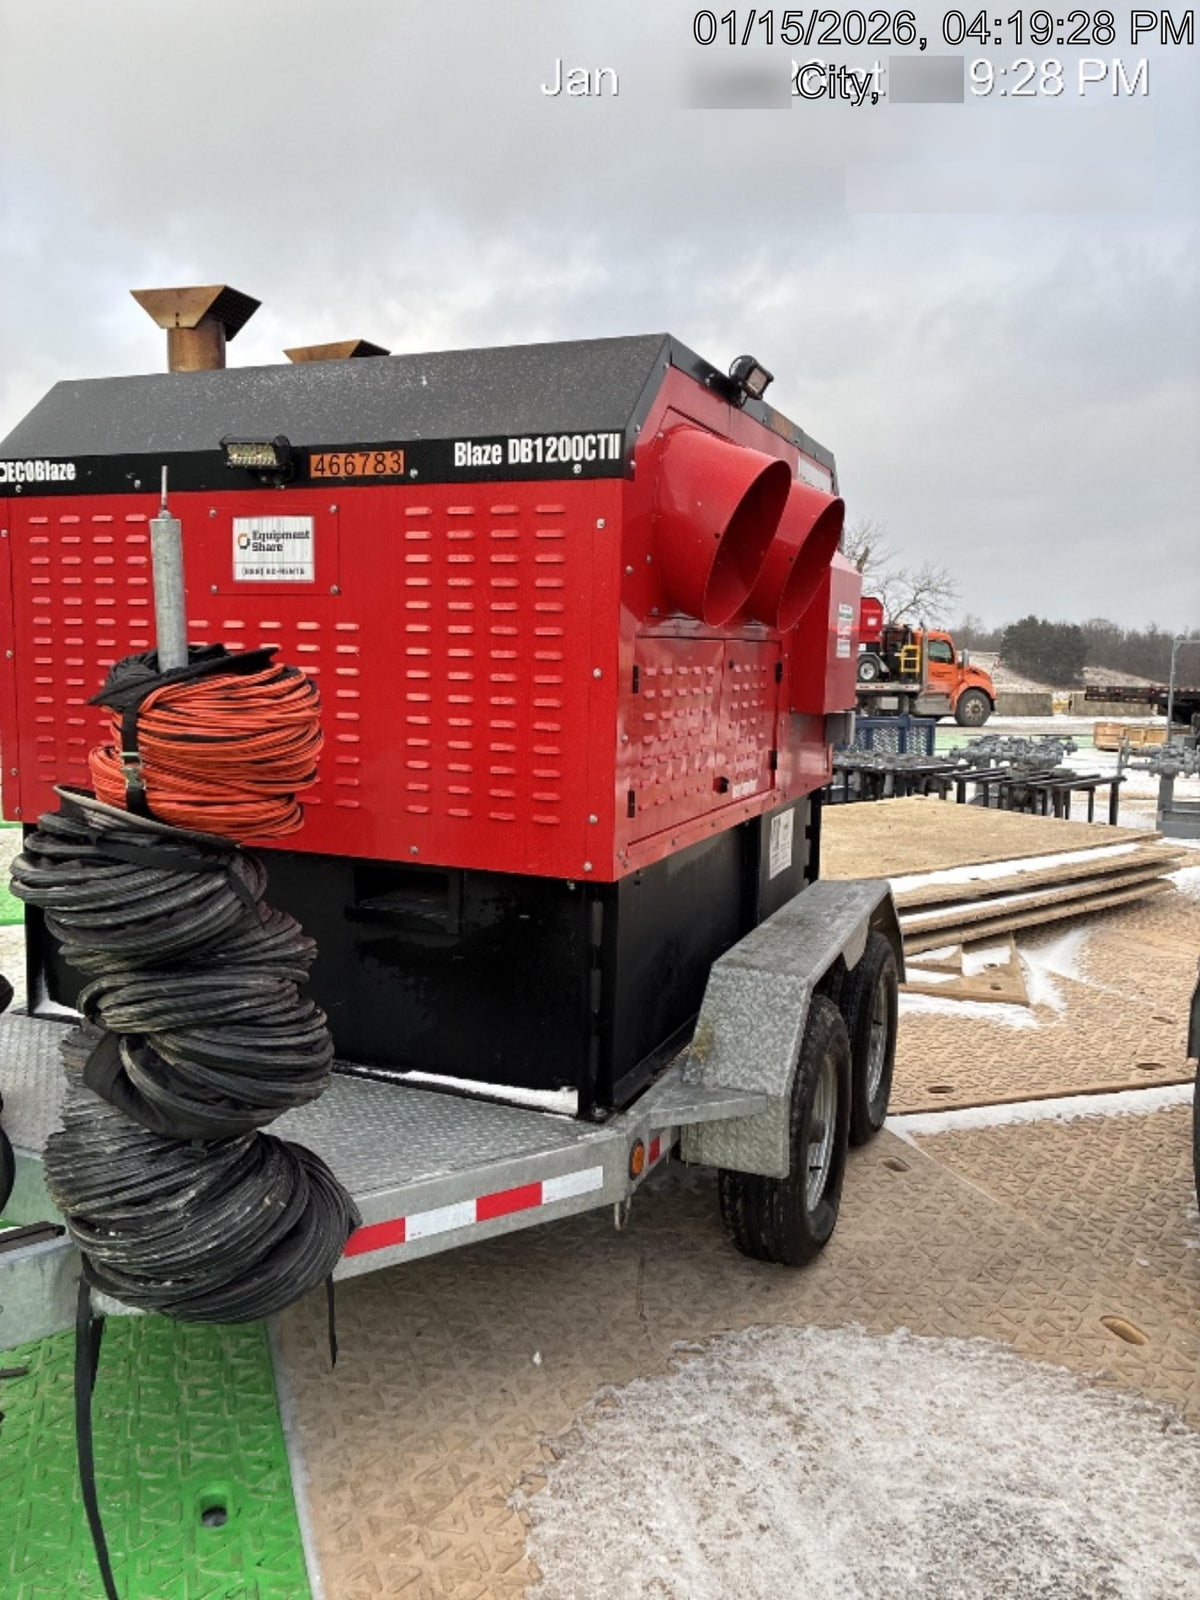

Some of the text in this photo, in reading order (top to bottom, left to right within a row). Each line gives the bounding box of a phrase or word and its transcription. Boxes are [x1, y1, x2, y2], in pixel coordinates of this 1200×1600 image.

[454, 433, 621, 466] Blaze DB1200CTII
[313, 450, 402, 476] 466783
[252, 529, 310, 542] Equipment
[252, 541, 284, 552] Share
